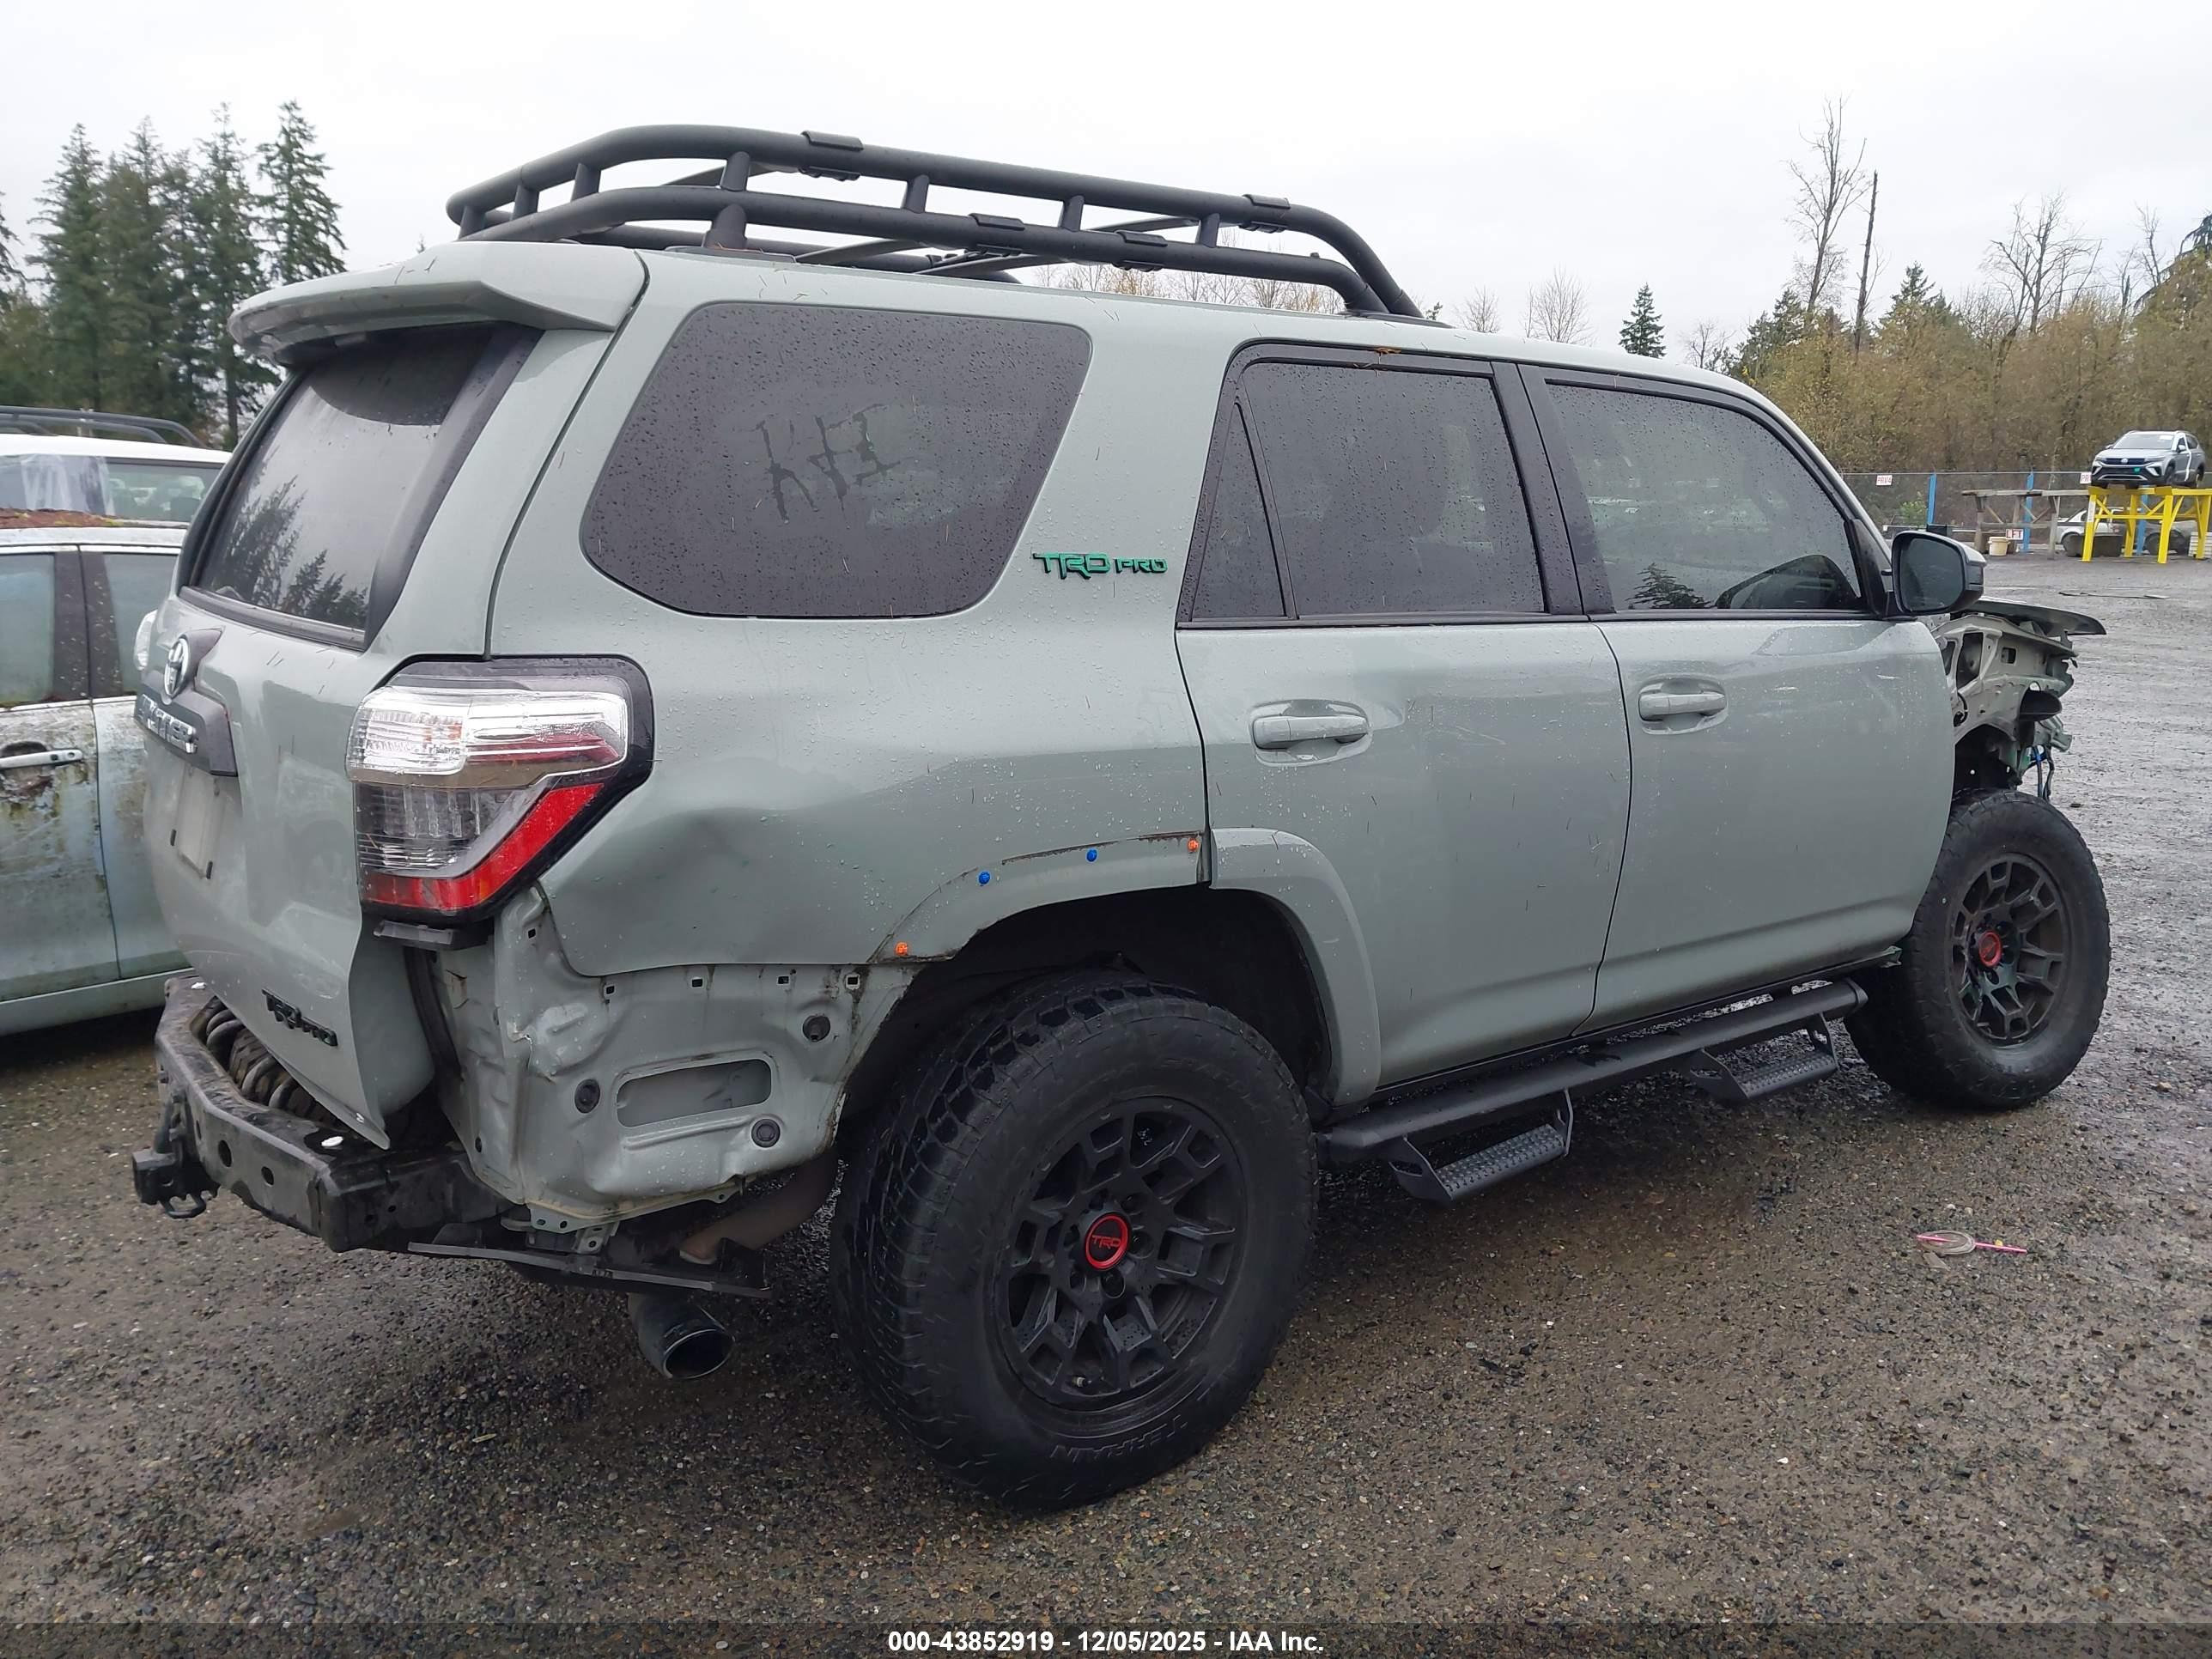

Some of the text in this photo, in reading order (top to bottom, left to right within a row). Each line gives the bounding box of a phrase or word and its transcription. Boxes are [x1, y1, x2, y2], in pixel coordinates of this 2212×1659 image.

[1033, 553, 1168, 580] TRD PRO
[262, 988, 302, 1029] TRD
[1091, 1234, 1121, 1249] TRD
